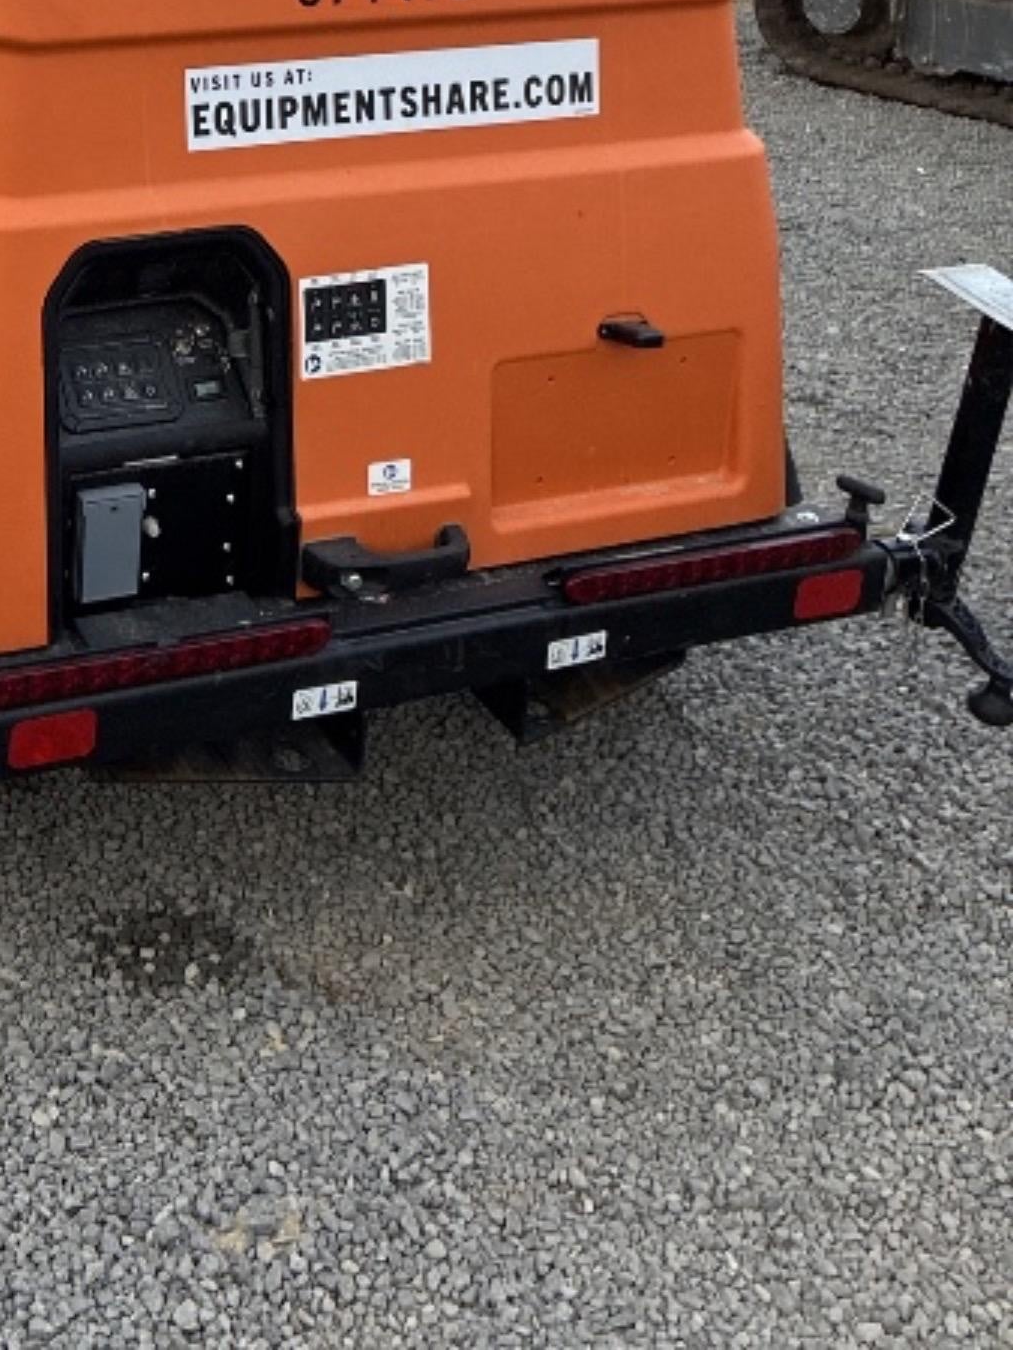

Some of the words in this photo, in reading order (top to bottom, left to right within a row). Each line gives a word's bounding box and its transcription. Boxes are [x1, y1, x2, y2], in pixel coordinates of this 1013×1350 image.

[191, 74, 240, 93] VISIT
[251, 71, 275, 88] US
[284, 68, 312, 85] AT:
[192, 71, 594, 138] EQUIPMENTSHARE.COM
